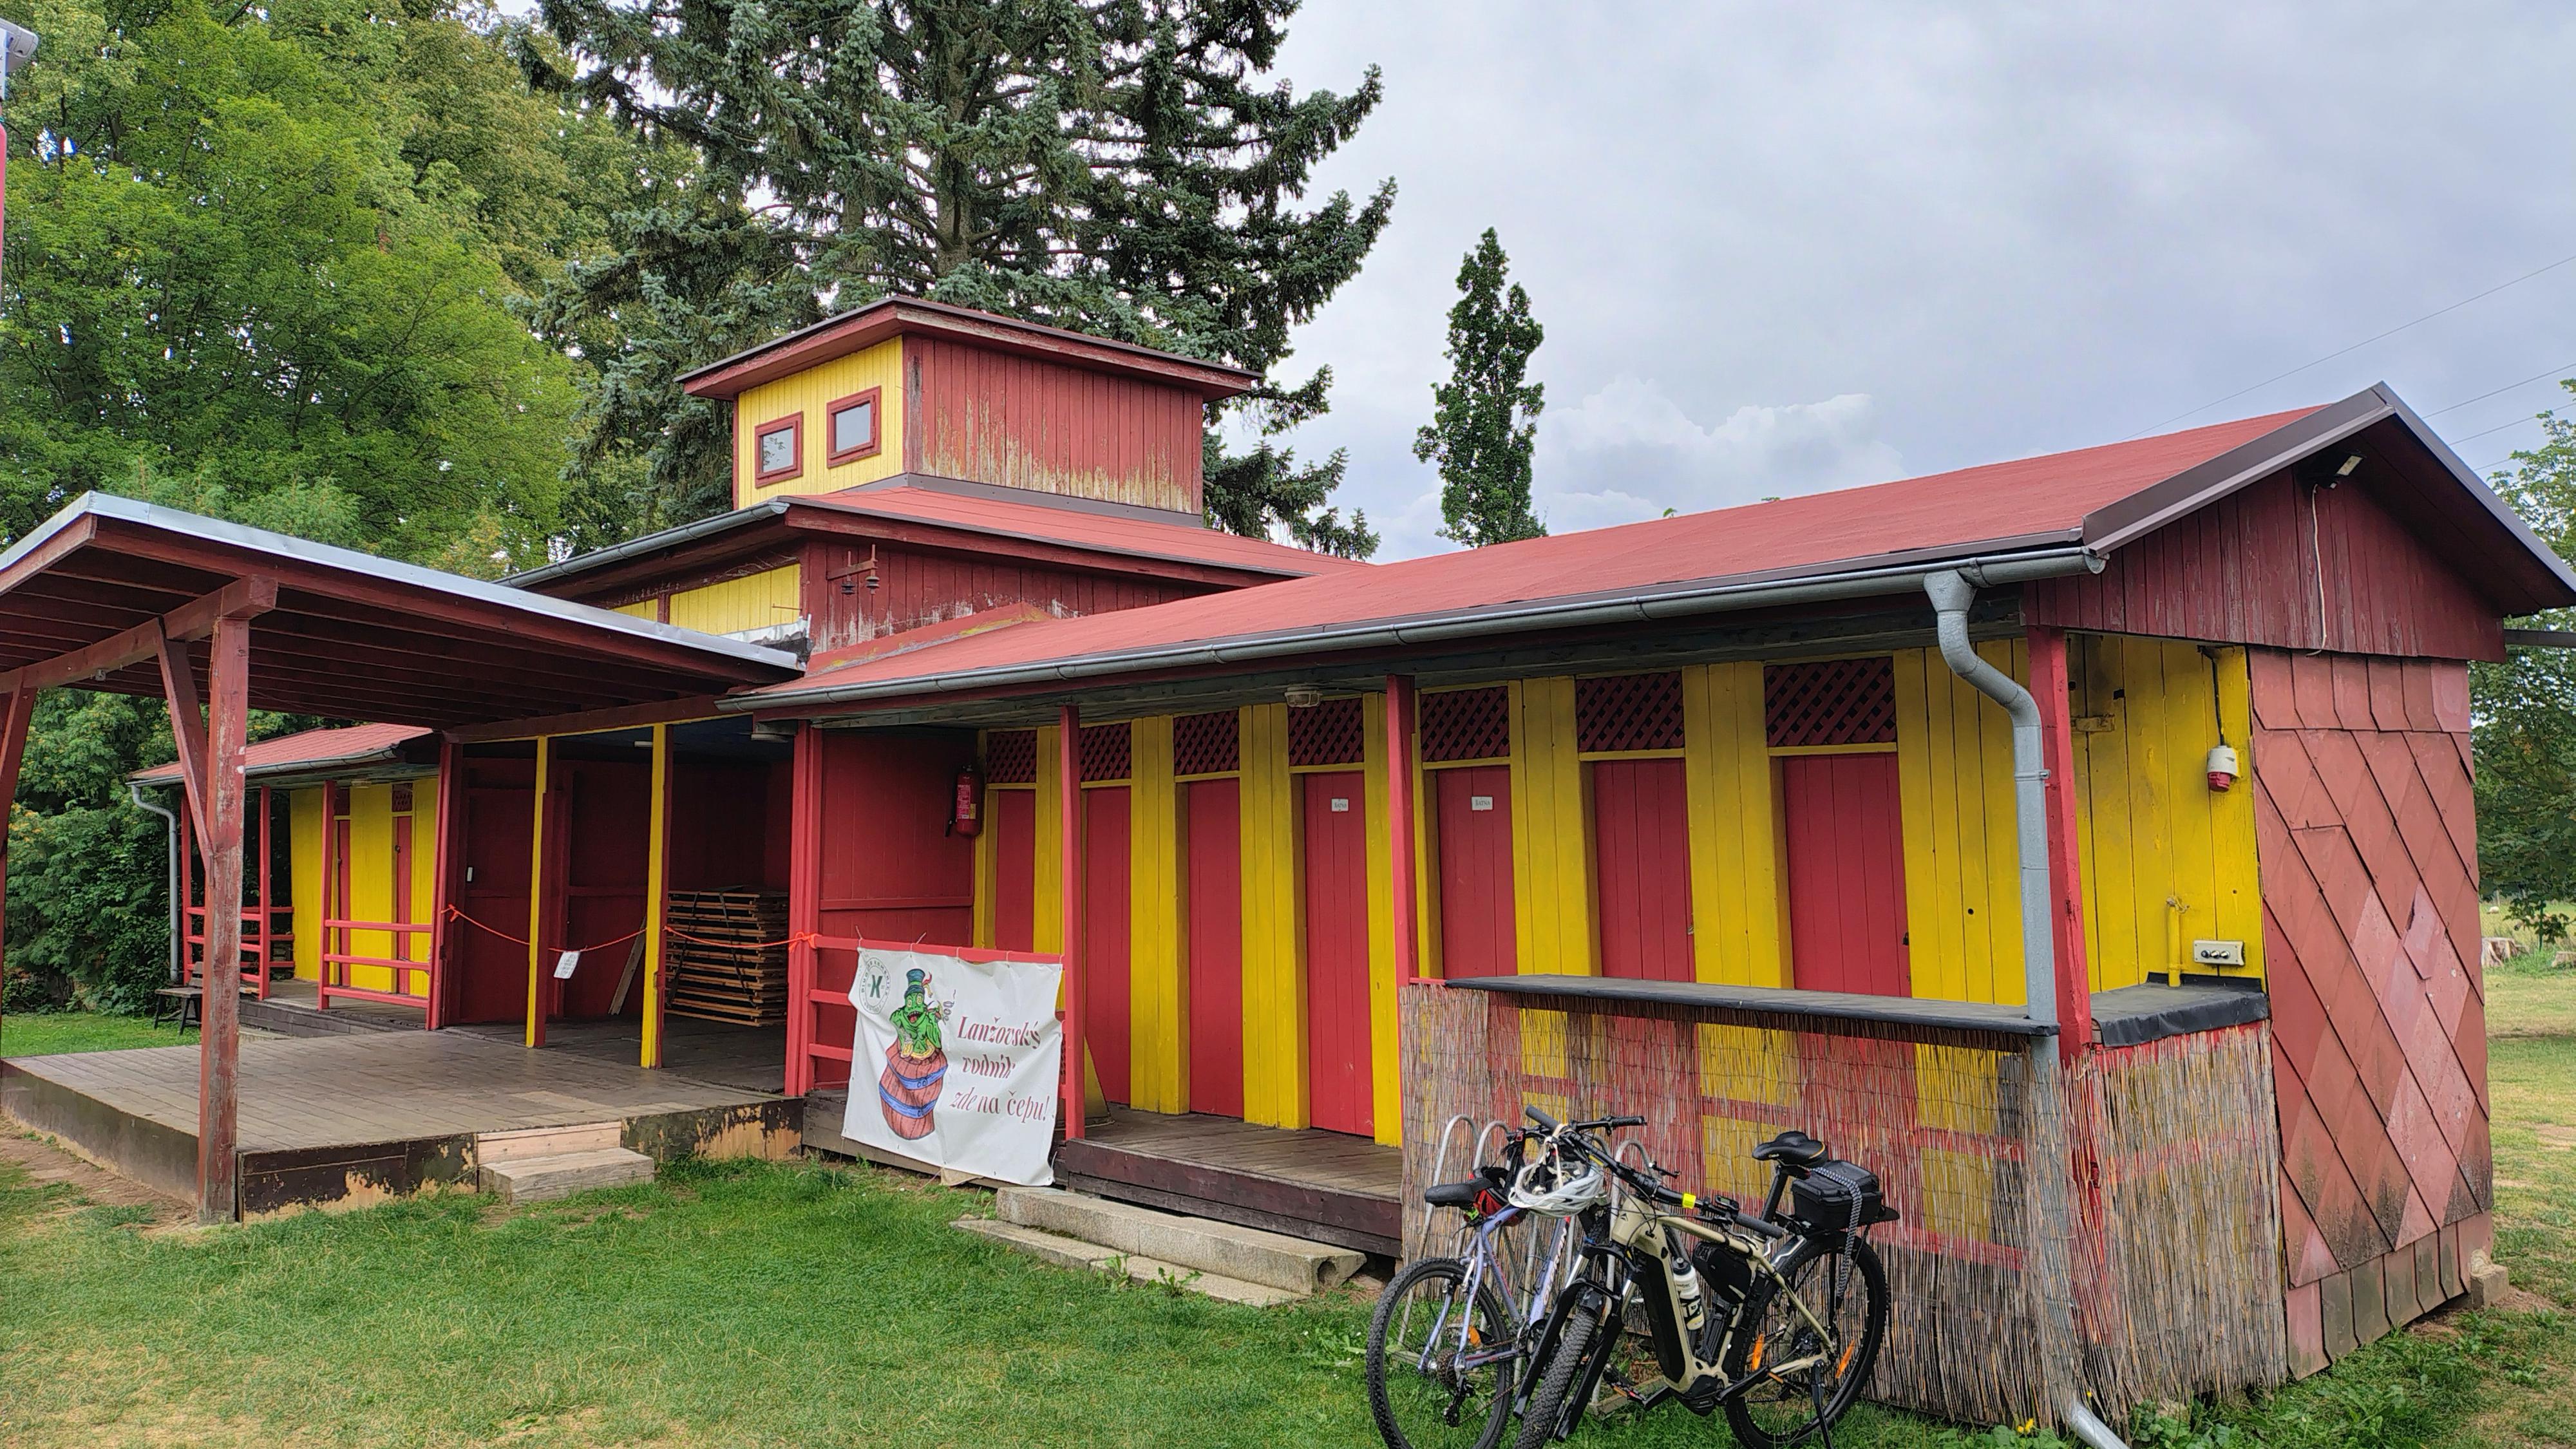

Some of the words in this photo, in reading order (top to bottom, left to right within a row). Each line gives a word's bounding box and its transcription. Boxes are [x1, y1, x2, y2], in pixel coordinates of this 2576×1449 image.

[958, 1016, 1041, 1049] Lanžovský
[962, 1054, 1016, 1079] vodník
[950, 1086, 978, 1111] zde
[977, 1094, 1001, 1114] na
[1007, 1090, 1050, 1123] čepu!
